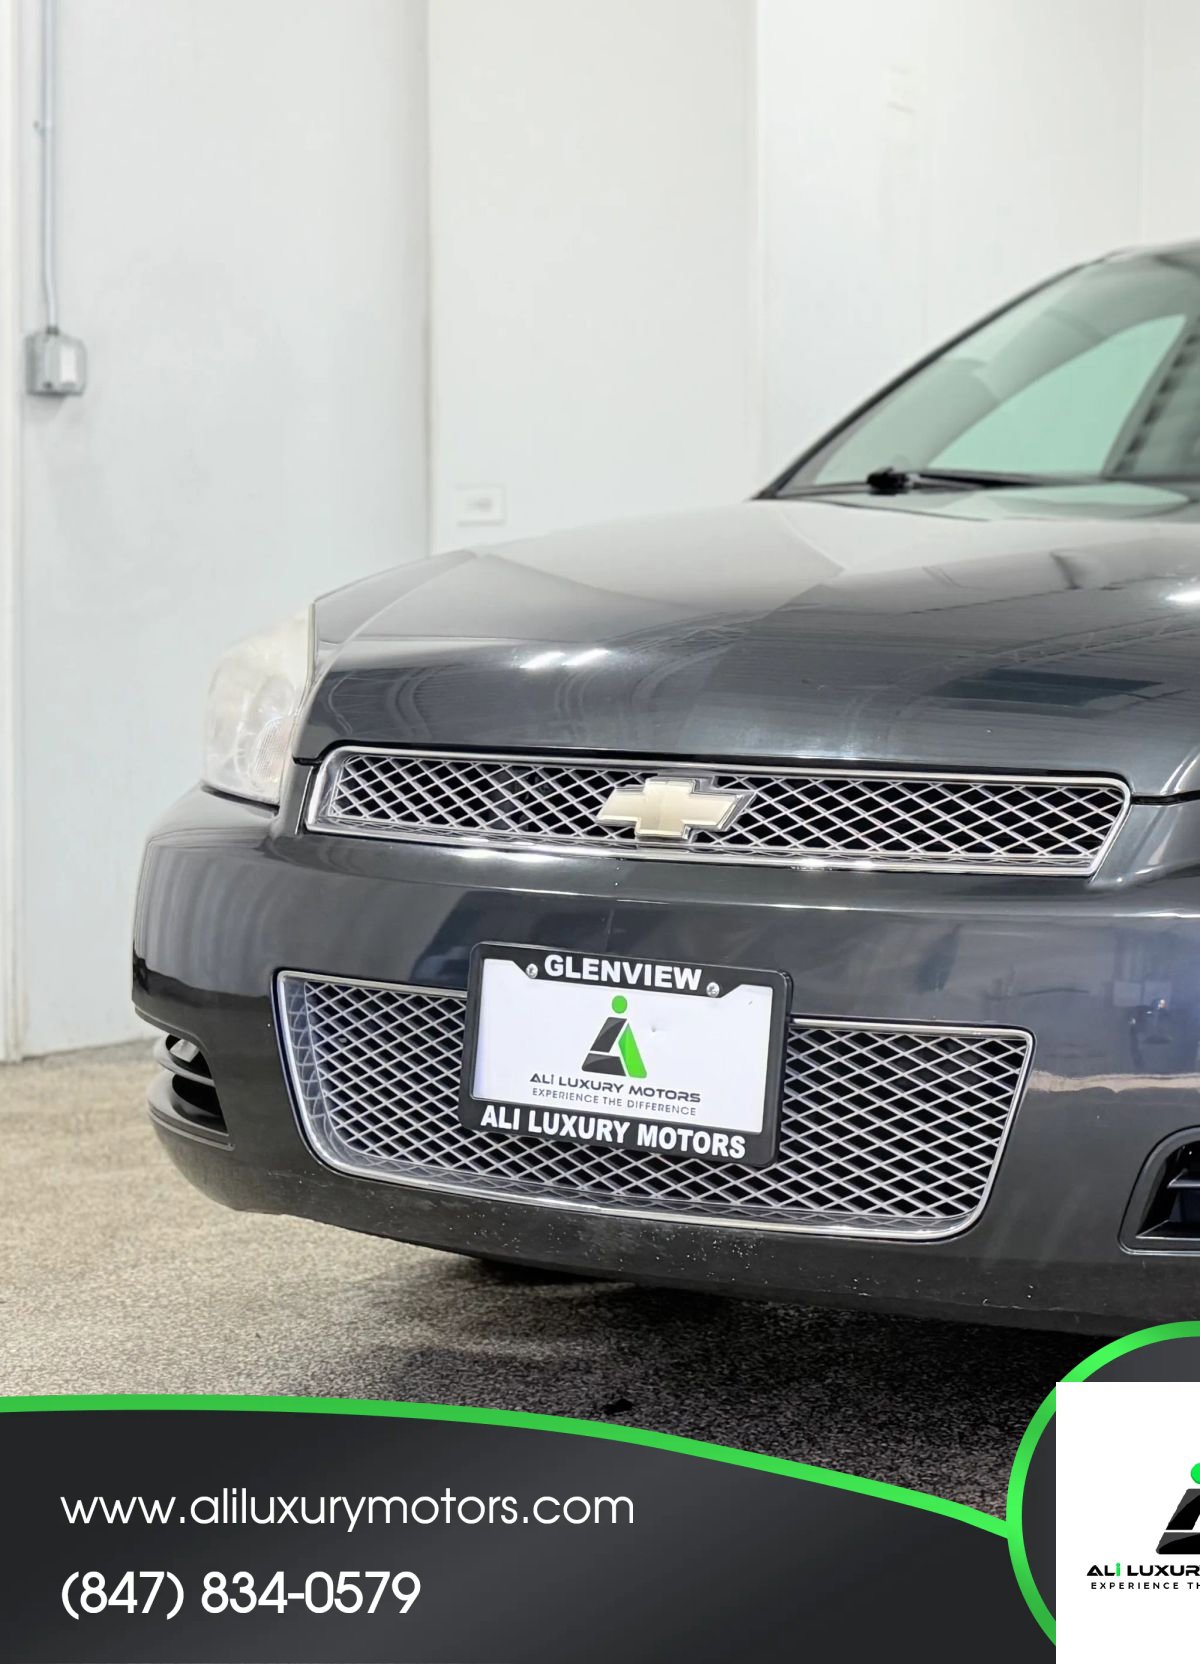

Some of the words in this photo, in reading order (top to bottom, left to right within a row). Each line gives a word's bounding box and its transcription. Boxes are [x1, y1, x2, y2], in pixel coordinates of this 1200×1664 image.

[543, 954, 702, 991] GLENVIEW
[532, 1087, 599, 1105] EXPERIENCE
[602, 1095, 623, 1107] THE
[626, 1098, 697, 1116] DIFFERENCE
[558, 1075, 625, 1093] LUXURY
[628, 1085, 702, 1103] MOTORS
[480, 1104, 521, 1131] ALI
[528, 1110, 632, 1143] LUXURY
[637, 1125, 746, 1159] MOTORS
